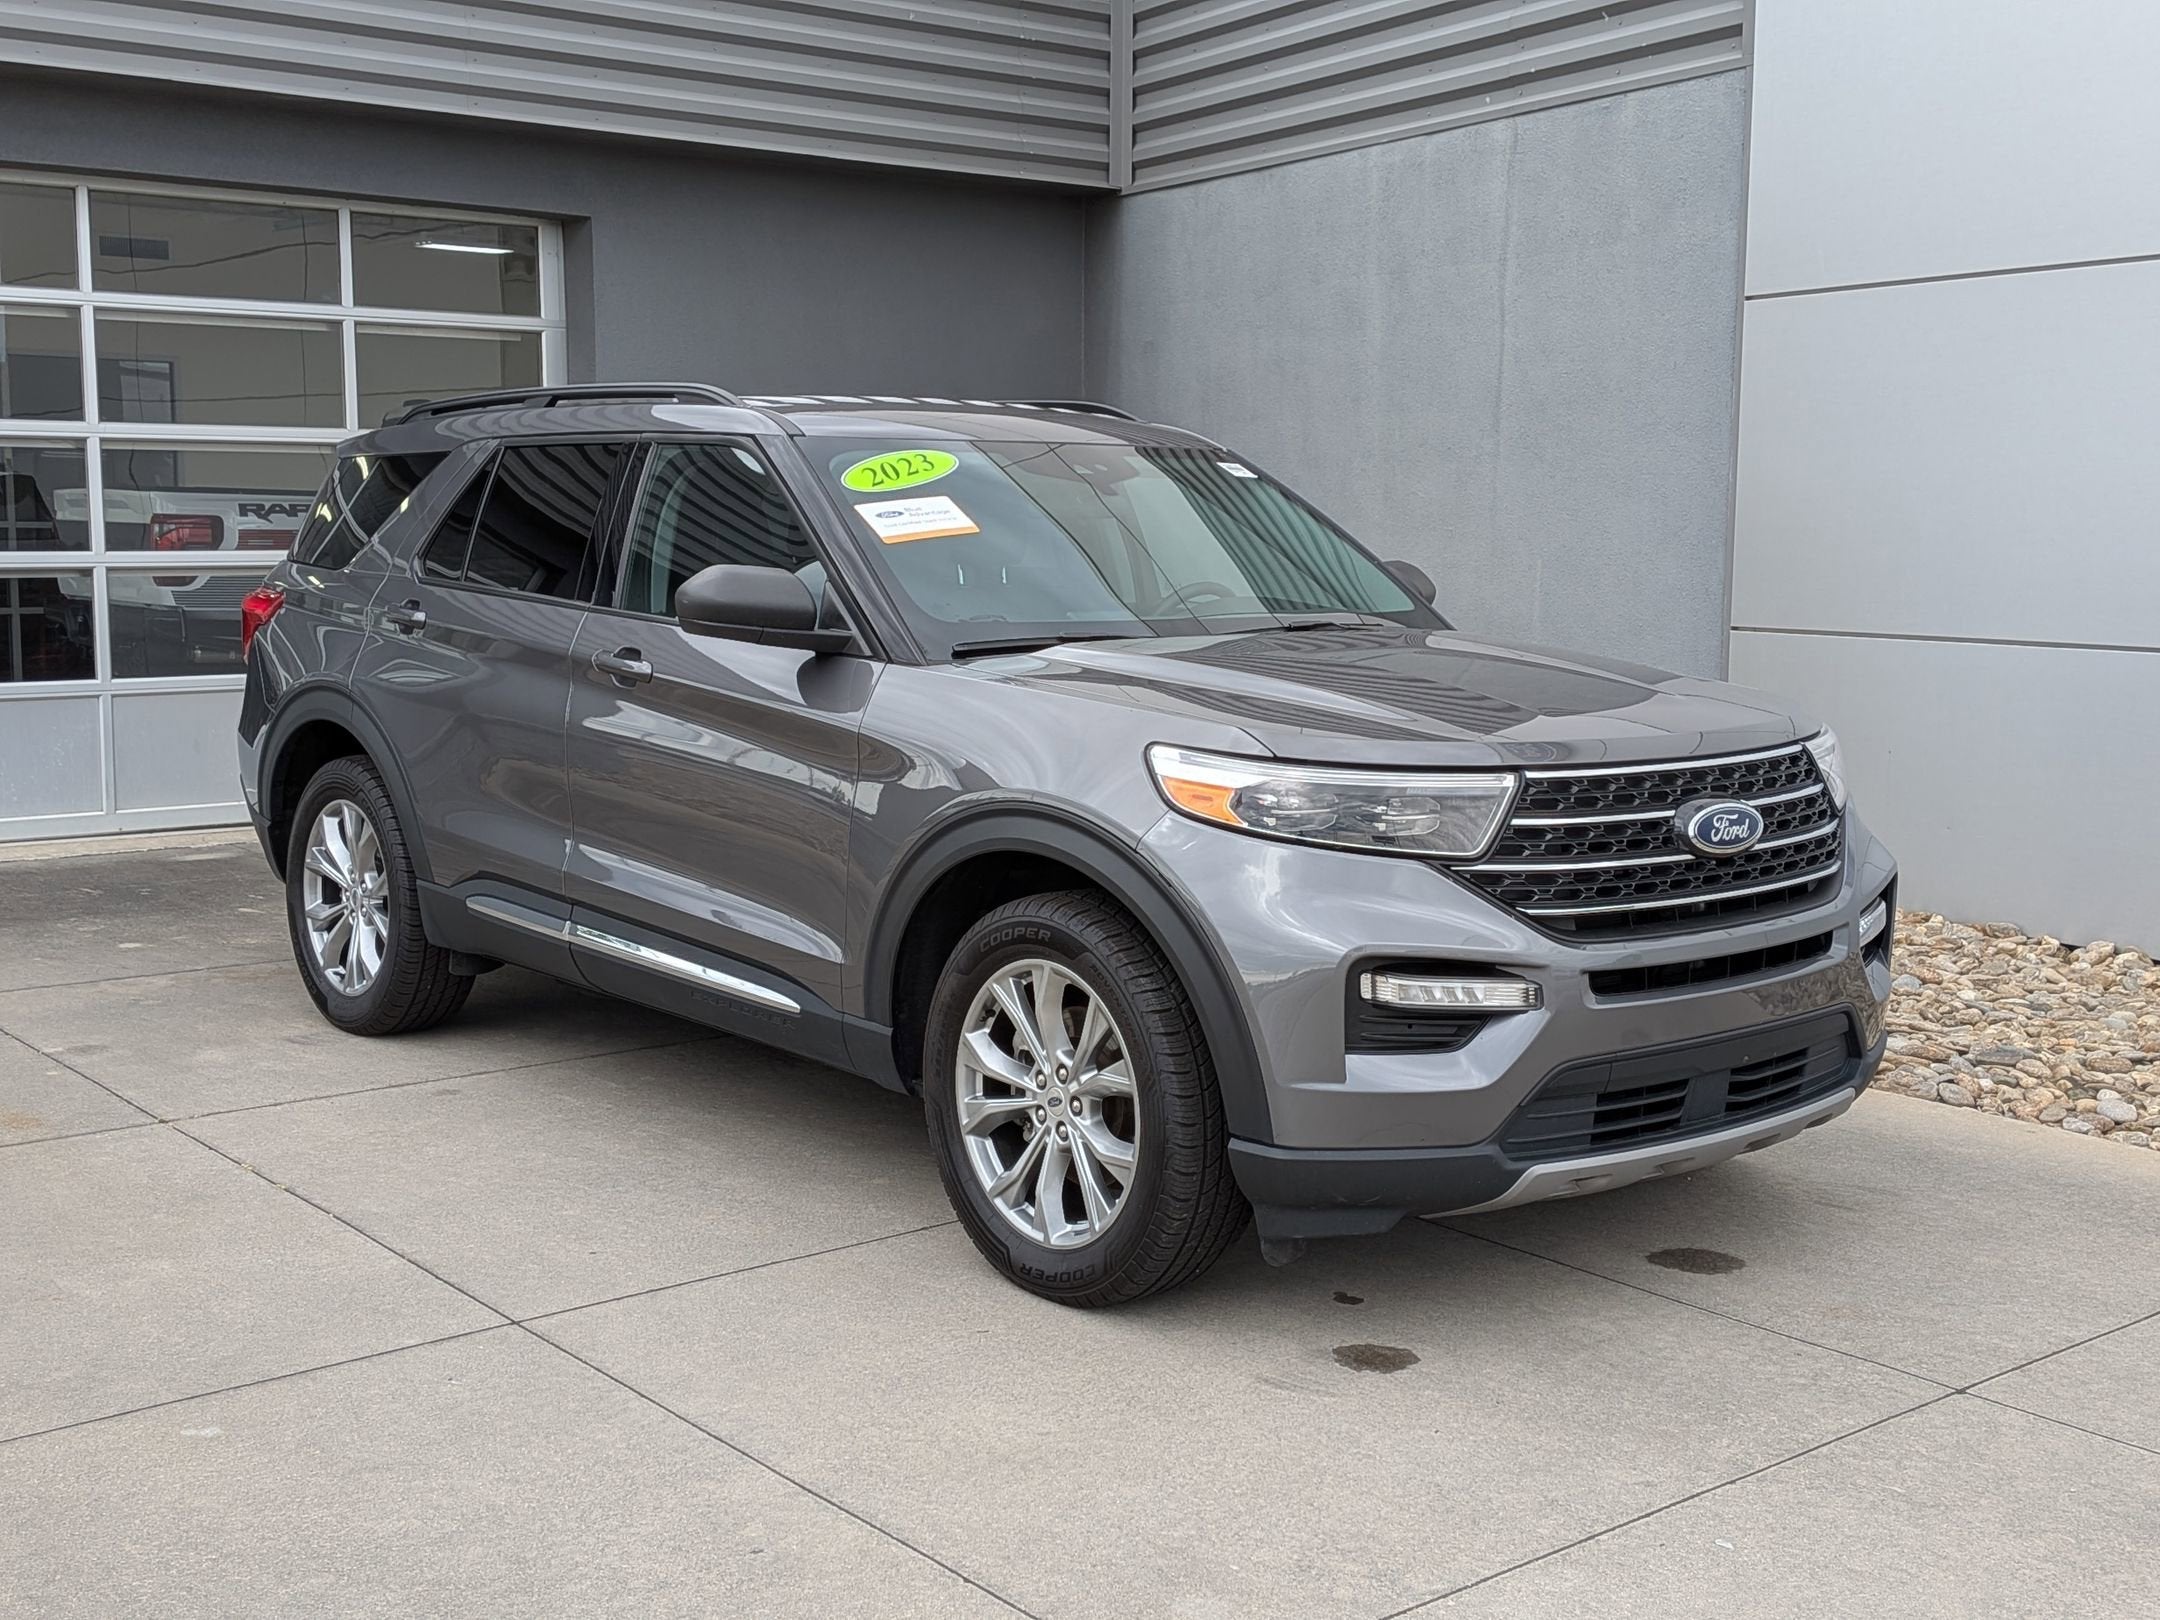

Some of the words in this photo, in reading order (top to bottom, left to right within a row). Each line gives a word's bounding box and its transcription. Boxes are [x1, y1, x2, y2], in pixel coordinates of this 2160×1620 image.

[862, 453, 935, 487] 2023
[1710, 813, 1750, 842] Ford
[980, 927, 1051, 952] COOPER
[1020, 1263, 1096, 1282] COOPER
